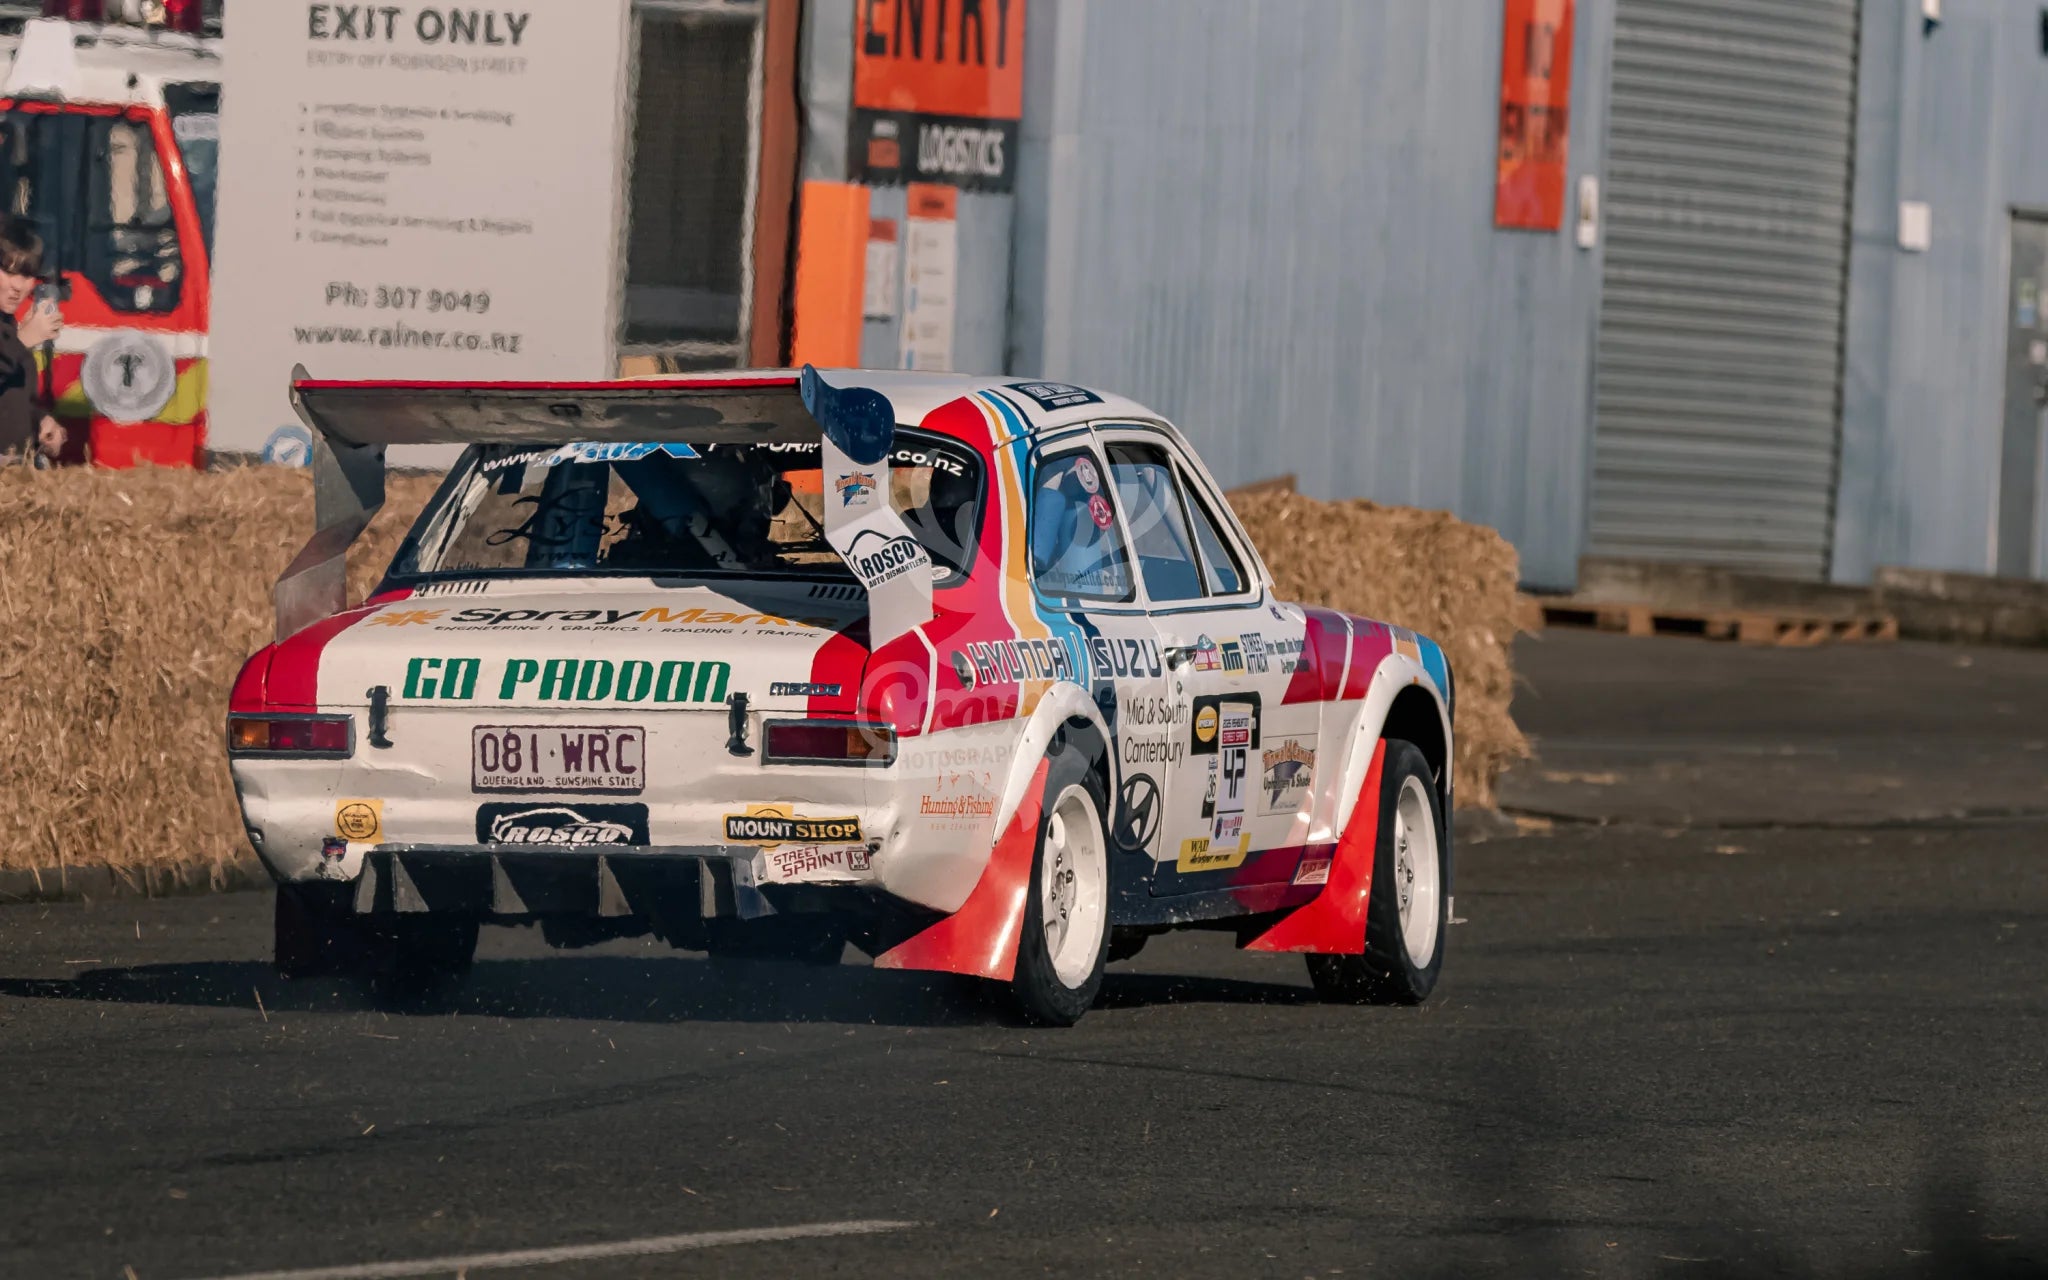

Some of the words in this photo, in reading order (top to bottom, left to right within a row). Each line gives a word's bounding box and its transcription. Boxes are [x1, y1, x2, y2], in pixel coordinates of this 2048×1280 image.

[308, 4, 402, 40] EXIT
[415, 8, 531, 46] ONLY
[917, 124, 1005, 176] LOGISTICS
[325, 281, 368, 307] Ph:
[374, 284, 421, 310] 307
[427, 287, 491, 314] 9049
[860, 541, 916, 580] ROSCO
[868, 573, 886, 589] AUTO
[885, 555, 928, 580] DISMANTLERS
[434, 625, 542, 633] ENGINEERING
[662, 627, 735, 636] ROADING
[755, 629, 821, 639] TRAFFIC
[967, 637, 1076, 685] HYUNDAI
[1084, 635, 1162, 681] ISUZU
[403, 657, 481, 700] GO
[499, 658, 732, 703] PADDON
[1125, 697, 1145, 726] Mid
[1146, 697, 1156, 725] &
[1157, 695, 1189, 725] South
[480, 732, 539, 774] 081
[560, 732, 638, 775] WRC
[1124, 733, 1185, 769] Canterbury
[482, 775, 545, 786] QUEENSLAND
[555, 776, 603, 786] SUNSHINE
[608, 776, 637, 787] STATE
[920, 794, 958, 820] Hunting
[966, 792, 995, 817] Fishing
[502, 825, 621, 843] ROSCO
[729, 819, 793, 837] MOUNT
[795, 823, 857, 839] SHOP
[773, 846, 819, 866] STREET
[781, 850, 844, 878] SPRINT
